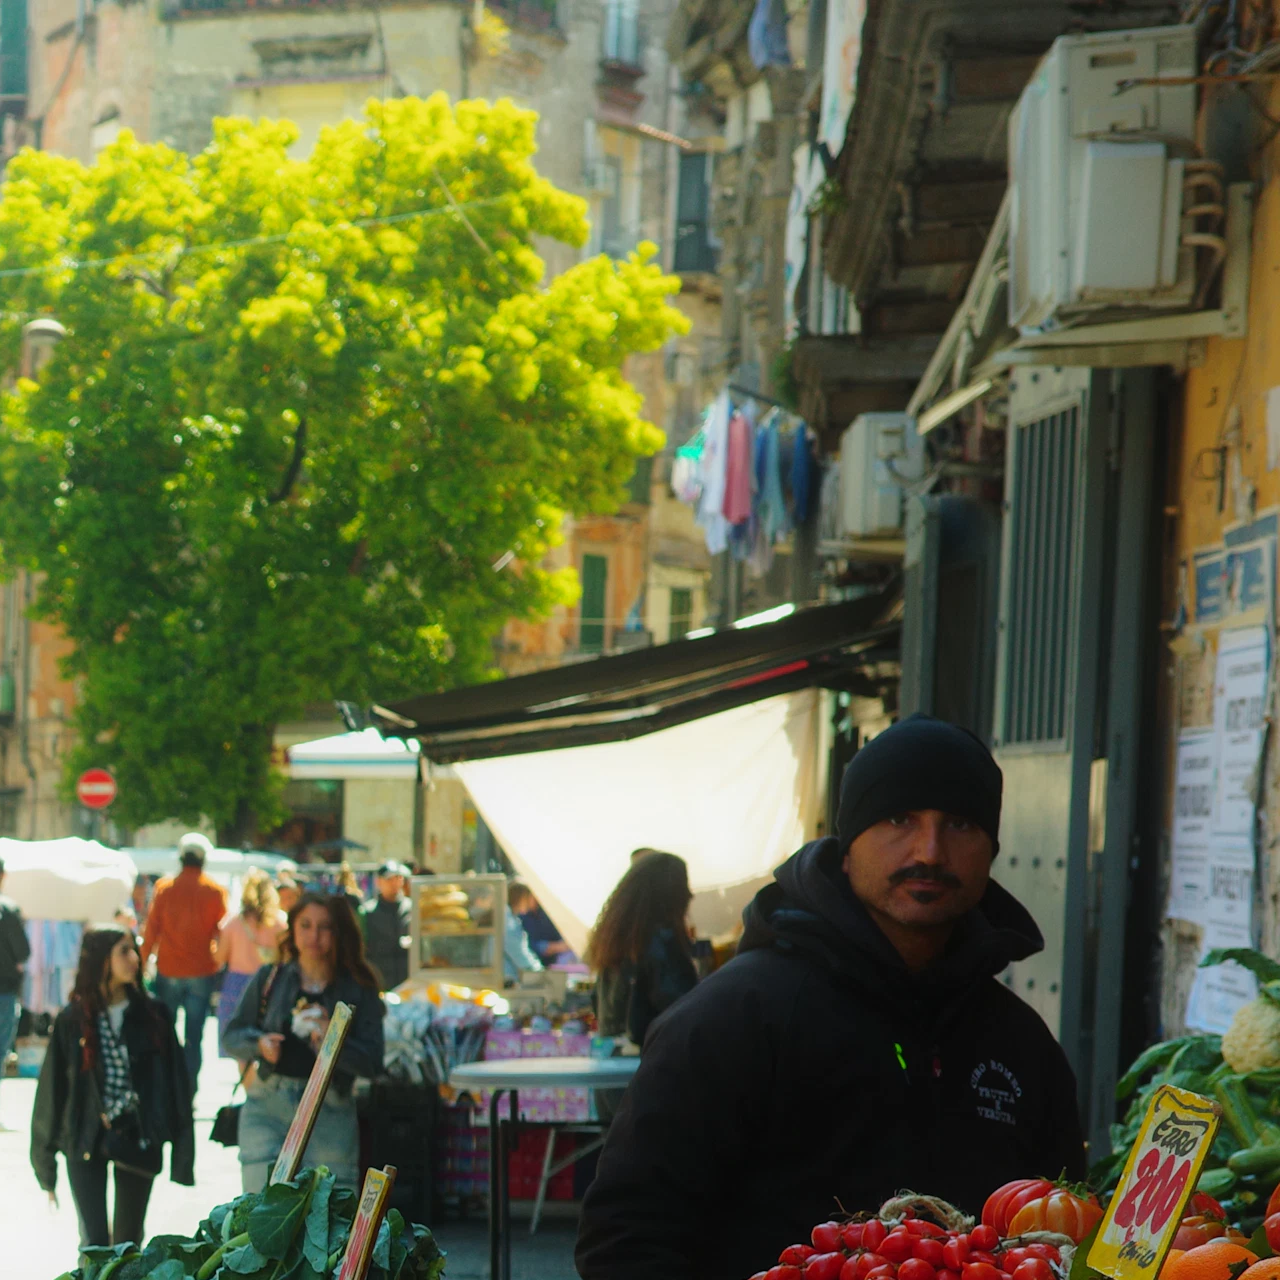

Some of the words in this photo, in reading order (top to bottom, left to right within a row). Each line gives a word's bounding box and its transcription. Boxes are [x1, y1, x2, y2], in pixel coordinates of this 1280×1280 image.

[970, 1061, 987, 1090] CIRO
[977, 1085, 1016, 1105] FRUTTA
[976, 1105, 1017, 1126] VERDURA
